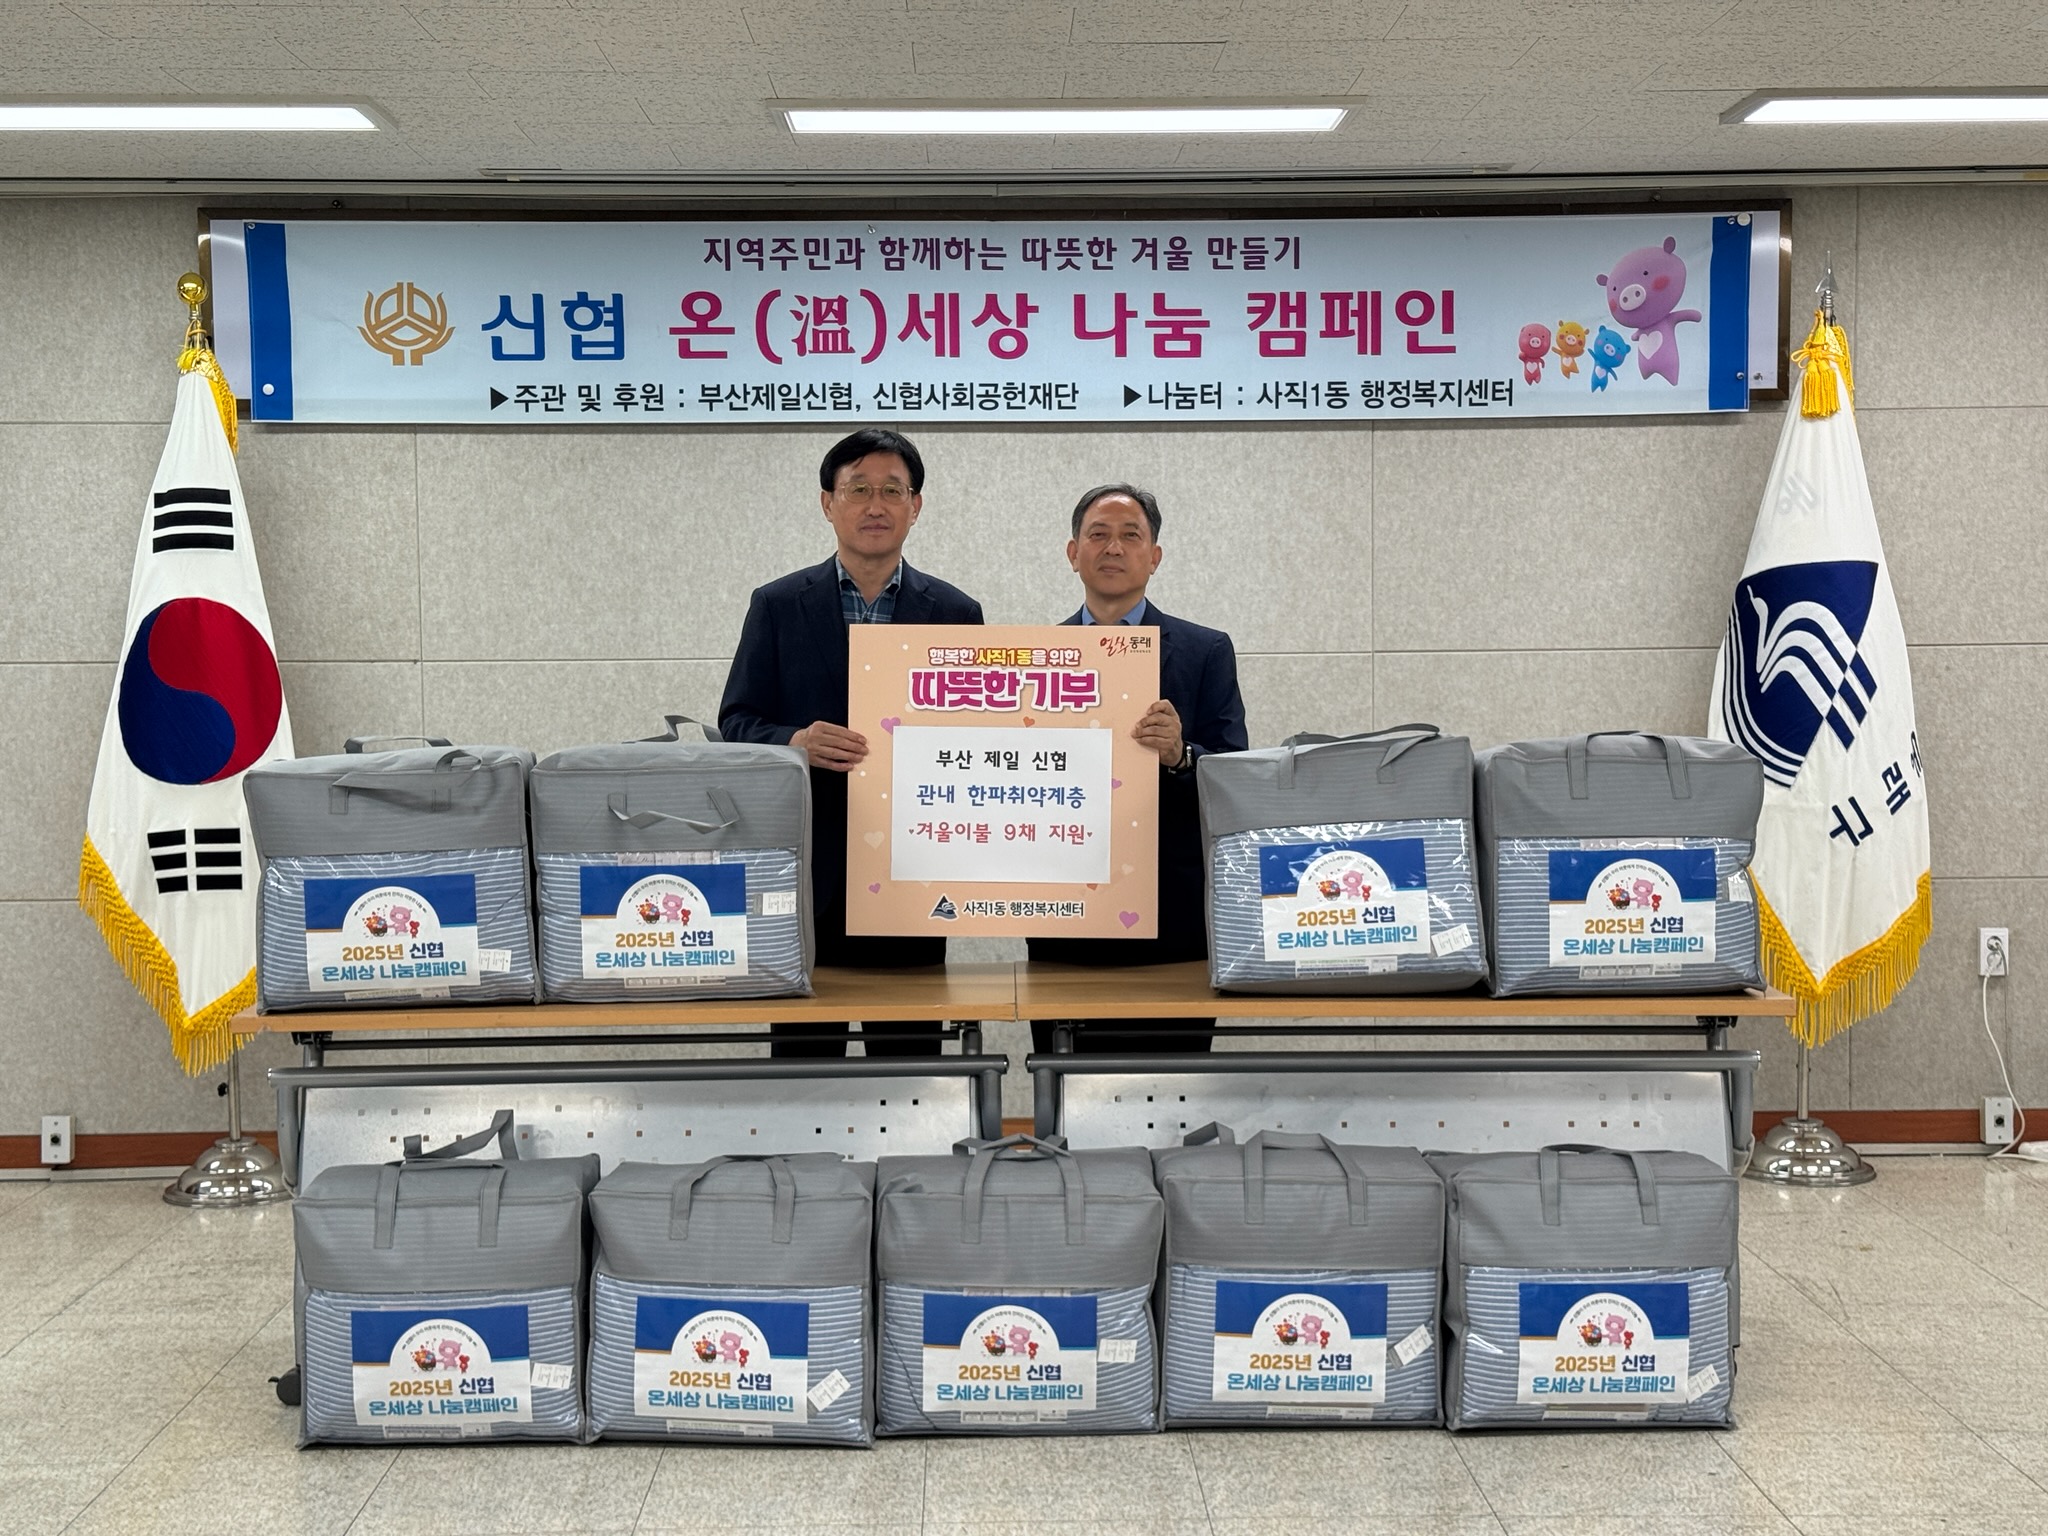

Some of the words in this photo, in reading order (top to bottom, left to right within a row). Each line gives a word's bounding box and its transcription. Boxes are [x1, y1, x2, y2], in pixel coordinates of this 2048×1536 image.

[703, 237, 865, 271] 지역주민과
[878, 236, 1007, 271] 함께하는
[1020, 236, 1117, 271] 따뜻한
[1131, 236, 1193, 271] 겨울
[1206, 235, 1302, 270] 만들기
[481, 291, 626, 361] 신협
[1072, 292, 1211, 358] 나눔
[1246, 290, 1458, 358] 캠페인
[513, 384, 566, 412] 주관
[579, 384, 603, 412] 및
[612, 384, 665, 412] 후원
[698, 384, 862, 413] 부산제일신협,
[873, 383, 1079, 411] 신협사회공헌재단
[1147, 382, 1223, 410] 나눔터
[1256, 381, 1350, 409] 사직1동
[1360, 379, 1514, 409] 행정복지센터
[1129, 636, 1151, 649] 동래
[928, 648, 975, 666] 행복한
[976, 648, 1048, 667] 사직1동을
[1049, 649, 1081, 666] 위한
[911, 670, 1020, 709] 따뜻한
[1025, 671, 1098, 709] 기부
[936, 750, 973, 770] 부산
[983, 751, 1019, 770] 제일
[1031, 751, 1067, 771] 신협
[916, 784, 955, 806] 관내
[967, 785, 1086, 809] 한파취약계층
[916, 822, 992, 843] 겨울이불
[1004, 823, 1036, 842] 9채
[1049, 824, 1085, 845] 지원
[963, 901, 1006, 916] 사직1동
[1009, 901, 1084, 917] 행정복지센터
[1297, 908, 1356, 927] 2025년
[1361, 906, 1395, 924] 신협
[1584, 918, 1644, 934] 2025년
[1649, 917, 1683, 934] 신협
[615, 932, 675, 948] 2025년
[680, 930, 714, 947] 신협
[1277, 932, 1328, 949] 온세상
[1333, 926, 1418, 945] 나눔캠페인
[1563, 939, 1615, 956] 온세상
[1620, 936, 1704, 954] 나눔캠페인
[342, 943, 404, 962] 2025년
[409, 942, 444, 959] 신협
[595, 952, 646, 968] 온세상
[651, 949, 736, 966] 나눔캠페인
[322, 966, 375, 982] 온세상
[379, 961, 467, 979] 나눔캠페인
[1250, 1354, 1312, 1371] 2025년
[1317, 1353, 1352, 1371] 신협
[1555, 1355, 1616, 1372] 2025년
[1621, 1354, 1656, 1372] 신협
[669, 1371, 731, 1389] 2025년
[736, 1372, 772, 1391] 신협
[958, 1364, 1021, 1381] 2025년
[1026, 1364, 1062, 1381] 신협
[1227, 1374, 1281, 1391] 온세상
[1286, 1374, 1373, 1391] 나눔캠페인
[389, 1379, 453, 1396] 2025년
[458, 1377, 495, 1394] 신협
[937, 1384, 990, 1401] 온세상
[995, 1384, 1083, 1401] 나눔캠페인
[1532, 1377, 1585, 1394] 온세상
[1589, 1375, 1676, 1393] 나눔캠페인
[369, 1400, 423, 1416] 온세상
[428, 1396, 518, 1414] 나눔캠페인
[648, 1390, 701, 1408] 온세상
[706, 1392, 794, 1412] 나눔캠페인
